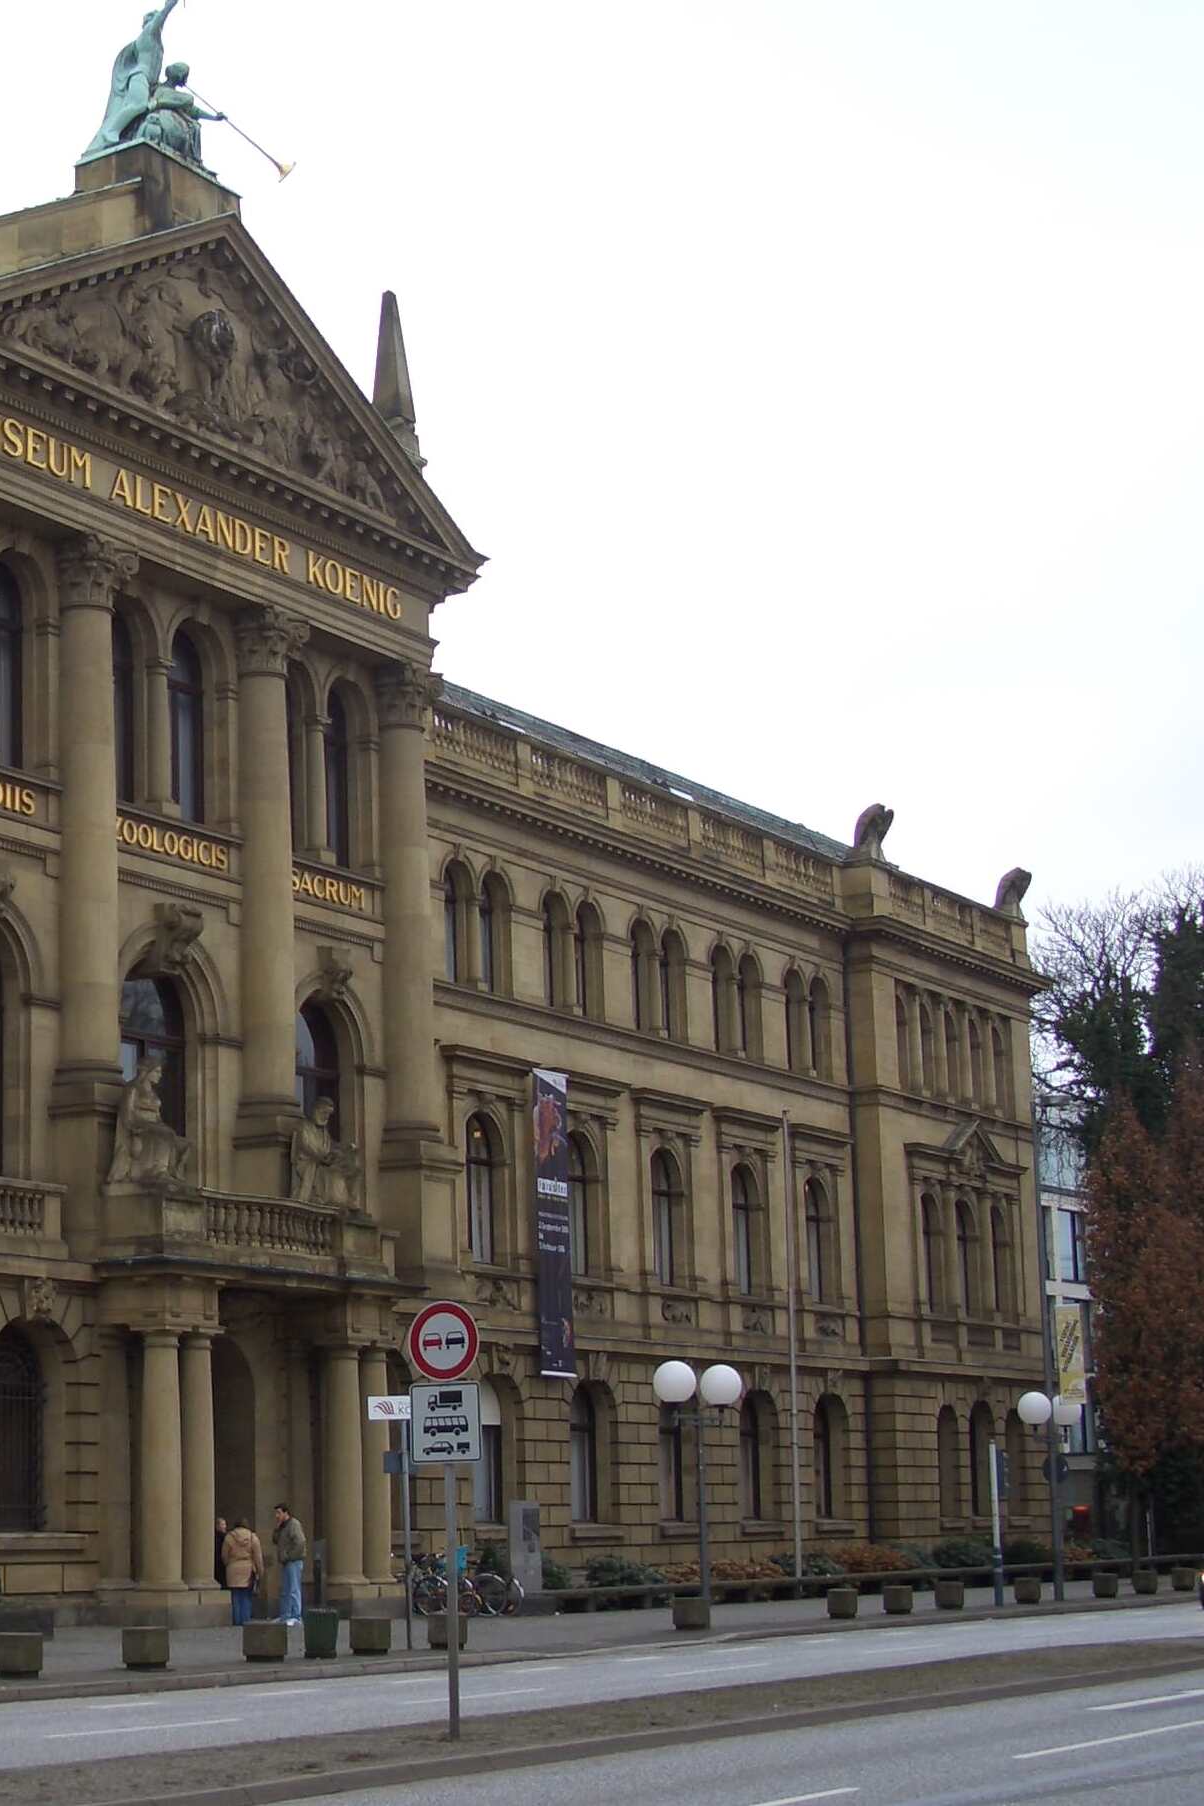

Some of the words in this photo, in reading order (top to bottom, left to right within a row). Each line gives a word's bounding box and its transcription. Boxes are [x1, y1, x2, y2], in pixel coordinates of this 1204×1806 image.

[109, 469, 291, 575] ALEXANDER
[306, 548, 403, 621] KOENIG
[291, 868, 366, 910] SACRUM
